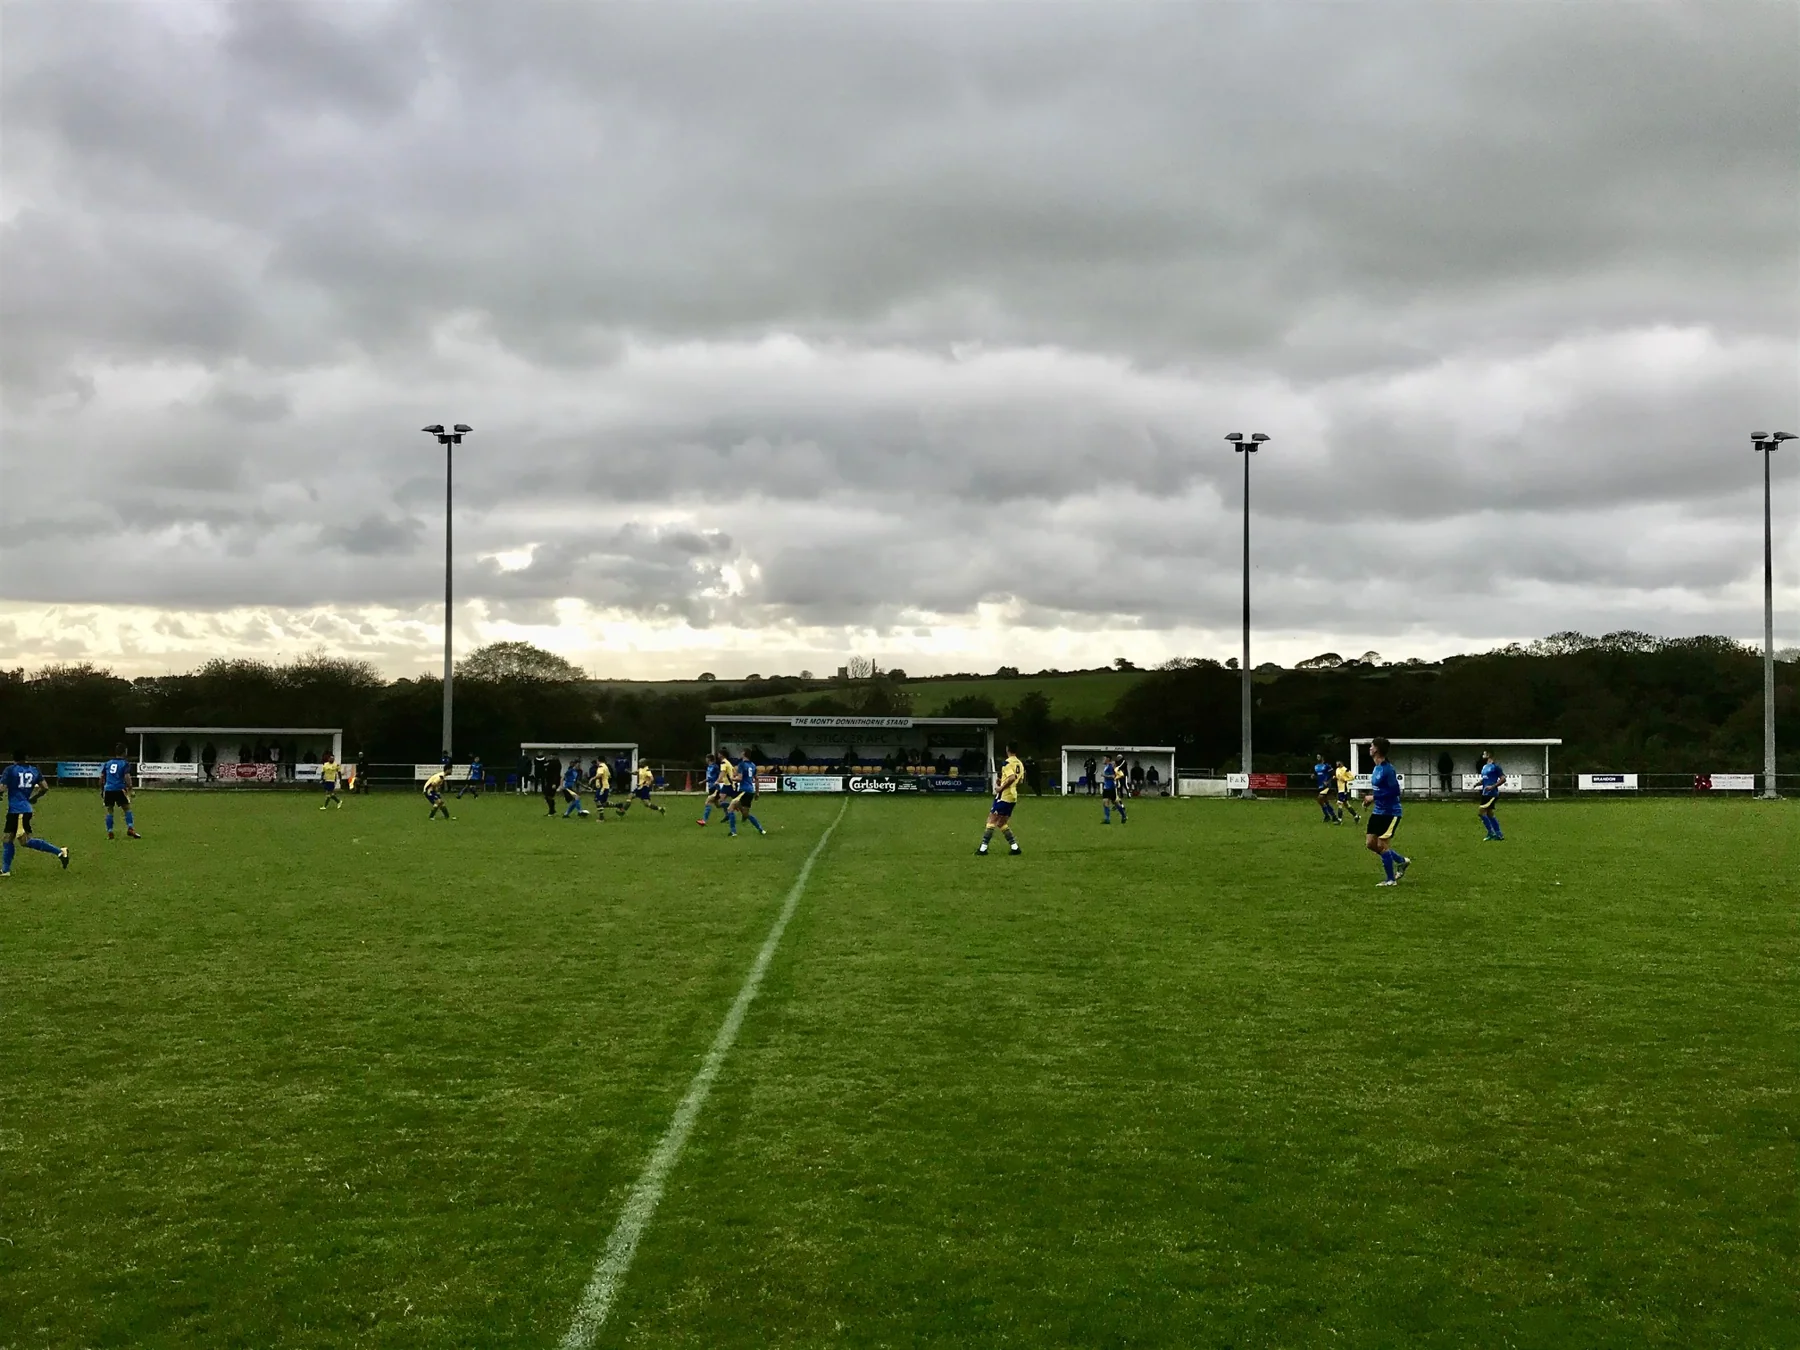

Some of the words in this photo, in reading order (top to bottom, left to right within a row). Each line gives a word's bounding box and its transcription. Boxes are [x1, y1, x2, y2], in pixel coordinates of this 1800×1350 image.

[109, 763, 118, 774] 9
[748, 767, 753, 777] 6
[18, 772, 33, 788] 12
[849, 777, 896, 792] Carlsberg
